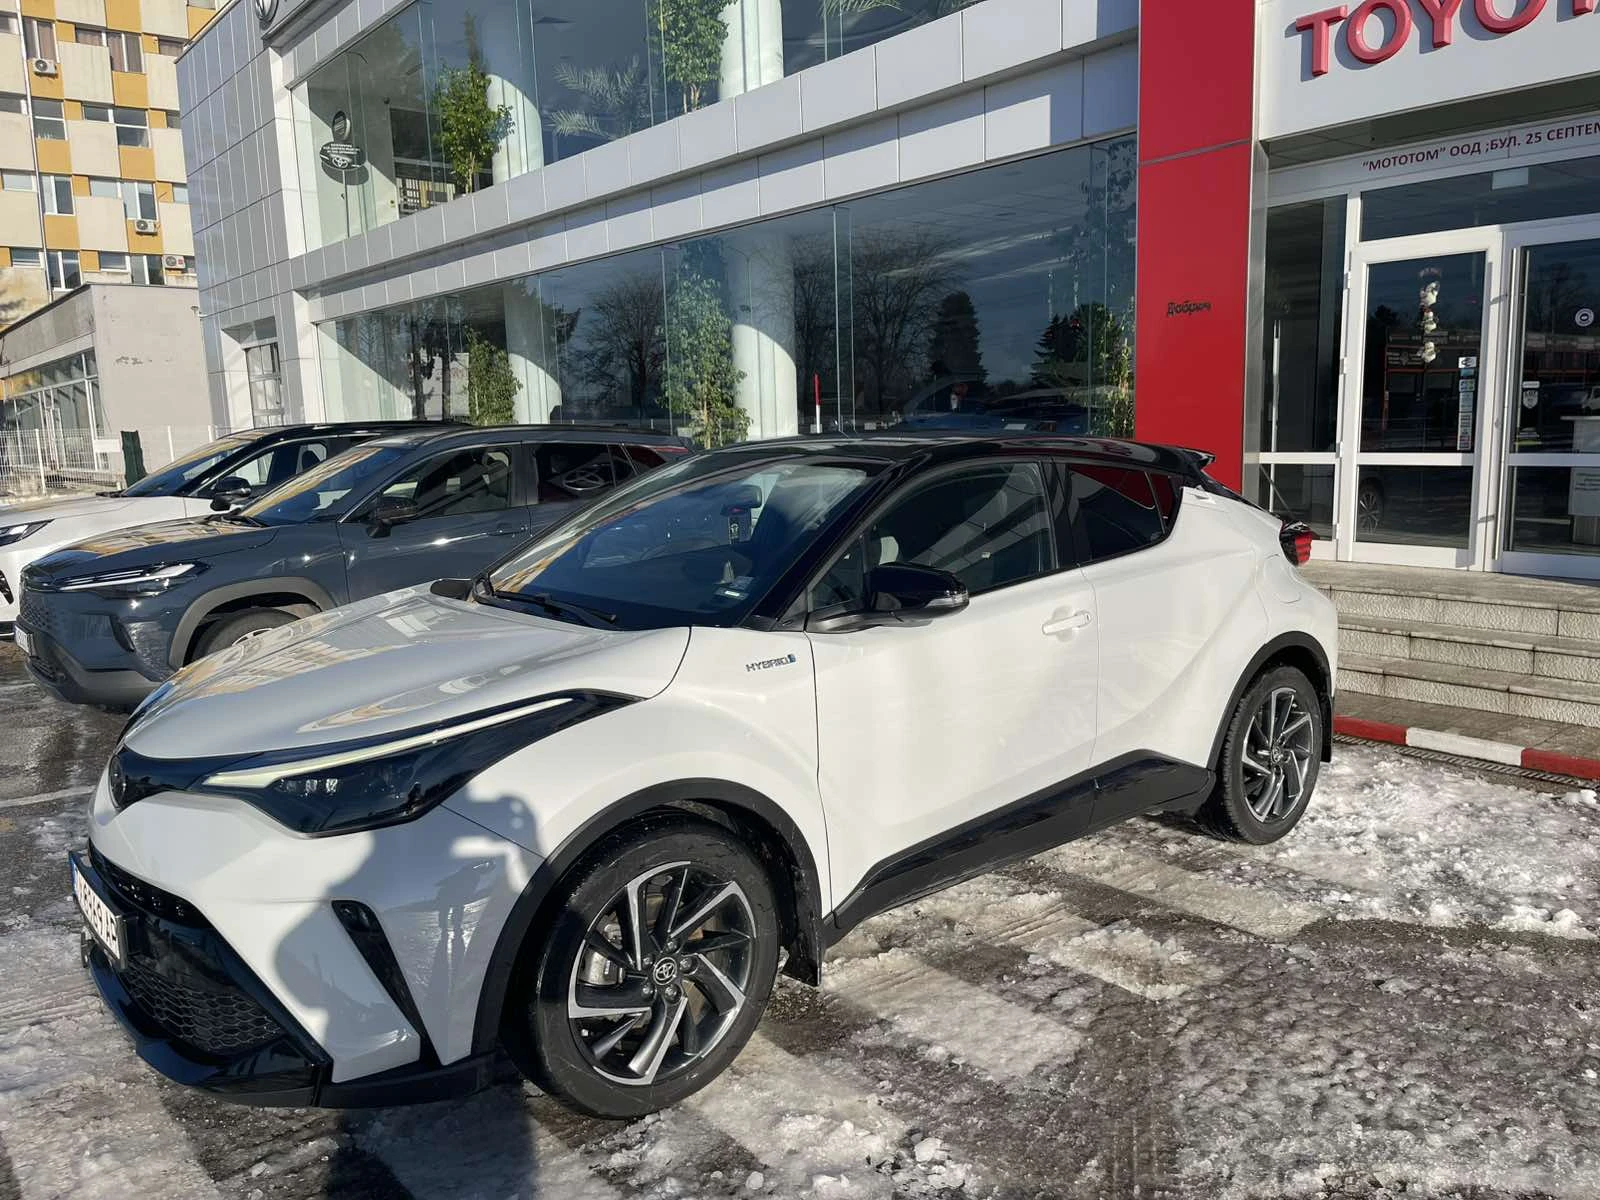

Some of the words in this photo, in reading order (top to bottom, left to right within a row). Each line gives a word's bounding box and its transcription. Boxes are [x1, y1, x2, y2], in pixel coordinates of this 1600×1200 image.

[1296, 0, 1594, 76] TOYO
[1449, 142, 1482, 158] ООД
[1525, 132, 1543, 146] 25
[746, 656, 788, 673] HYBRID
